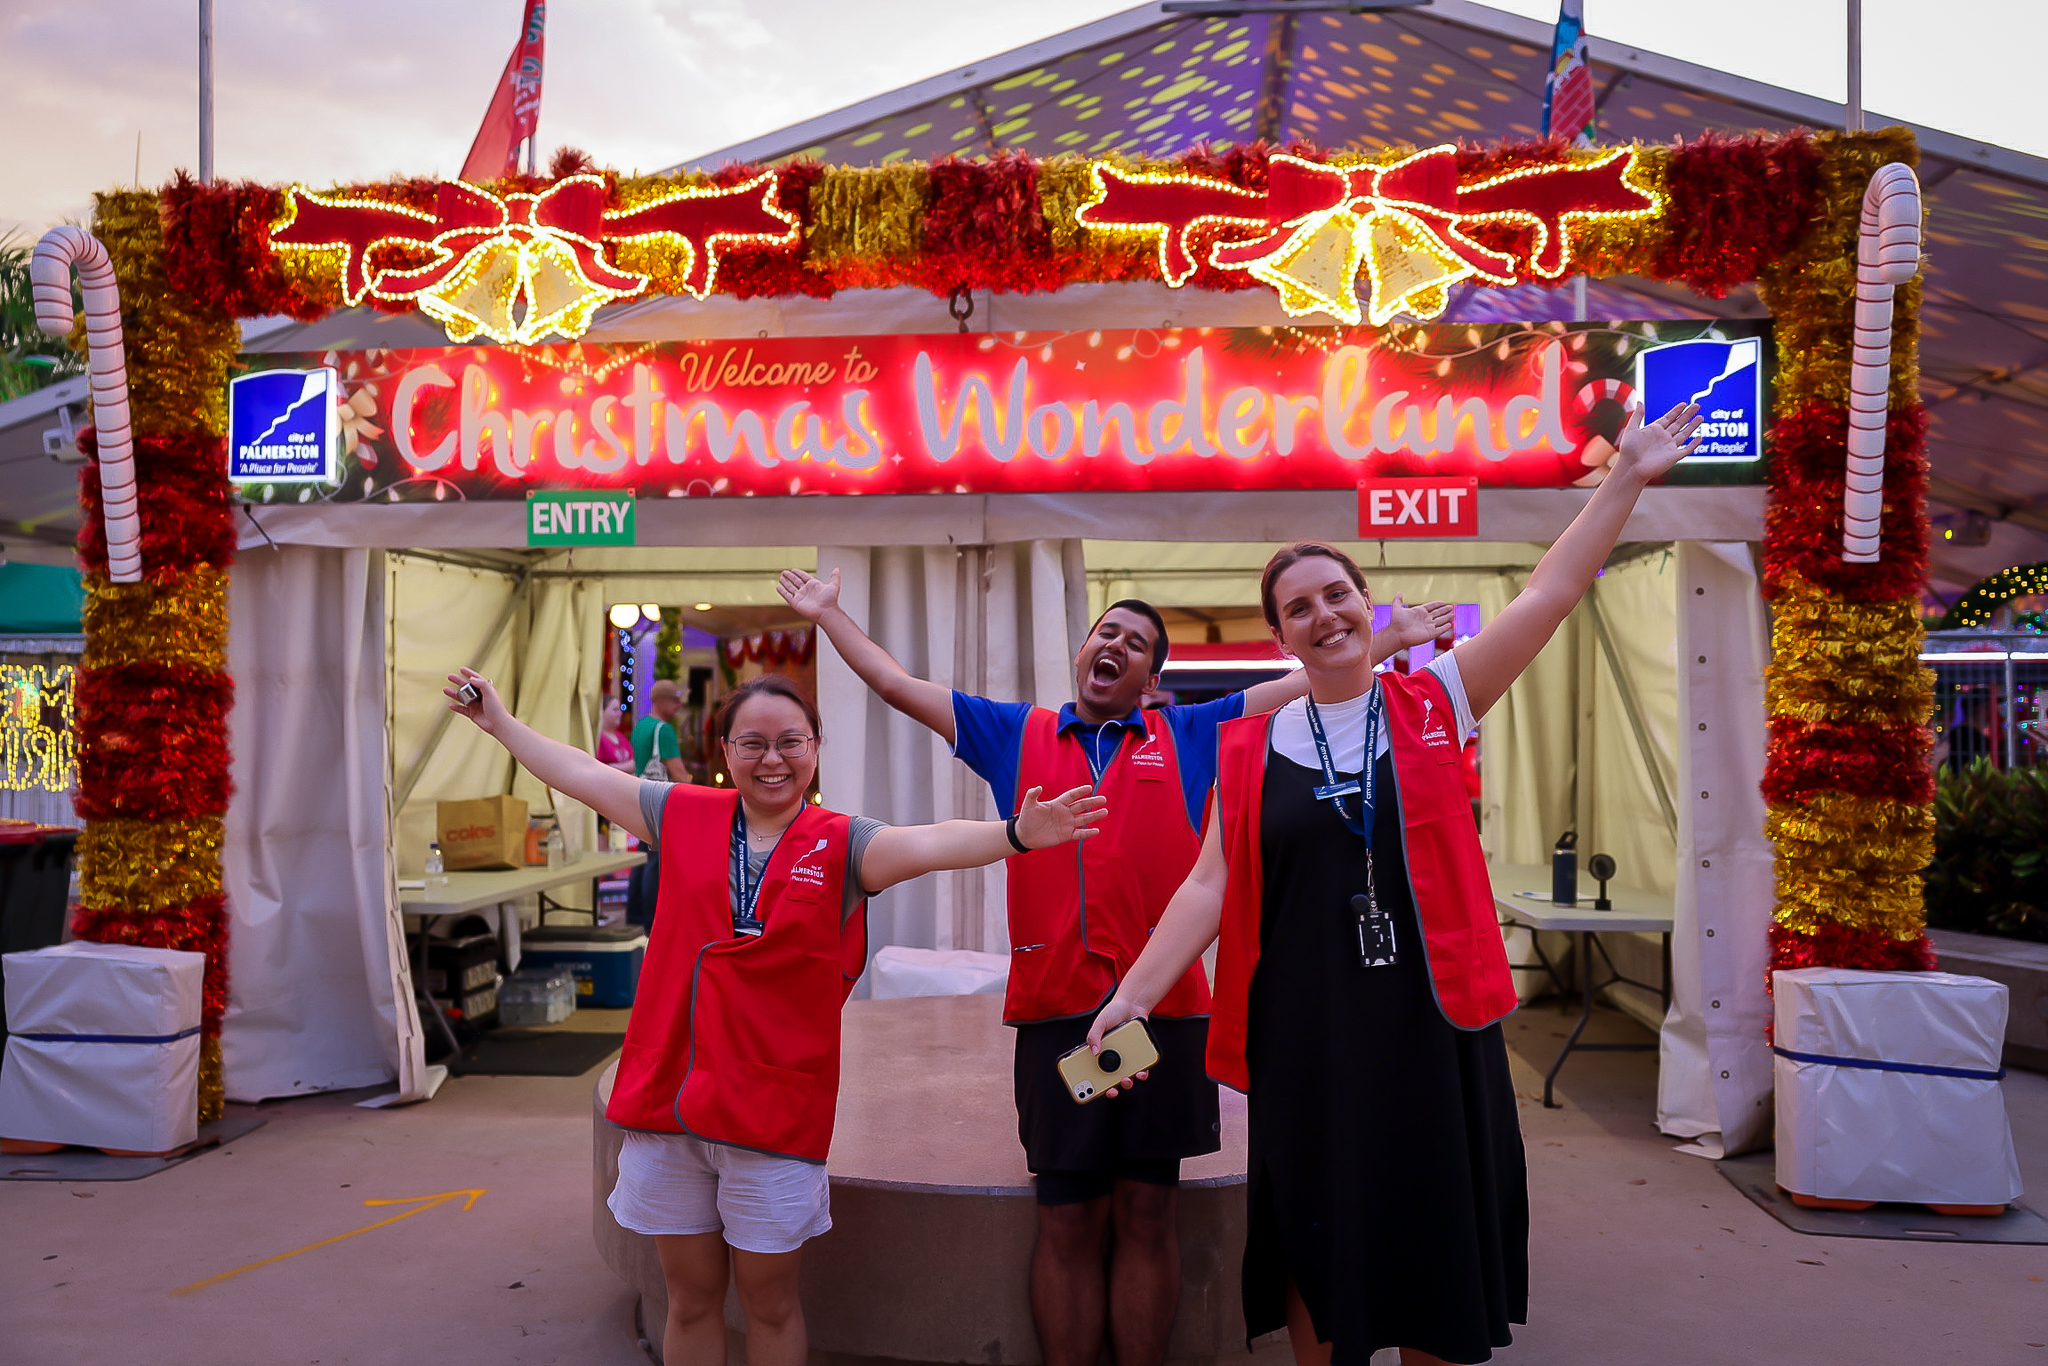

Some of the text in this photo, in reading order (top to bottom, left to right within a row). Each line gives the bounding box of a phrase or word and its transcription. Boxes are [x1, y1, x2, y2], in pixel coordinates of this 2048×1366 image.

[679, 346, 878, 394] Welcome to
[391, 339, 1575, 477] Christmas Wonderland
[1710, 408, 1743, 420] city of
[288, 432, 316, 444] city of
[1689, 422, 1748, 438] ERSTON
[240, 445, 320, 460] PALMERSTON
[249, 462, 272, 474] Place
[272, 462, 286, 474] for
[1370, 488, 1467, 526] EXIT
[532, 501, 631, 535] ENTRY
[446, 824, 496, 842] coles
